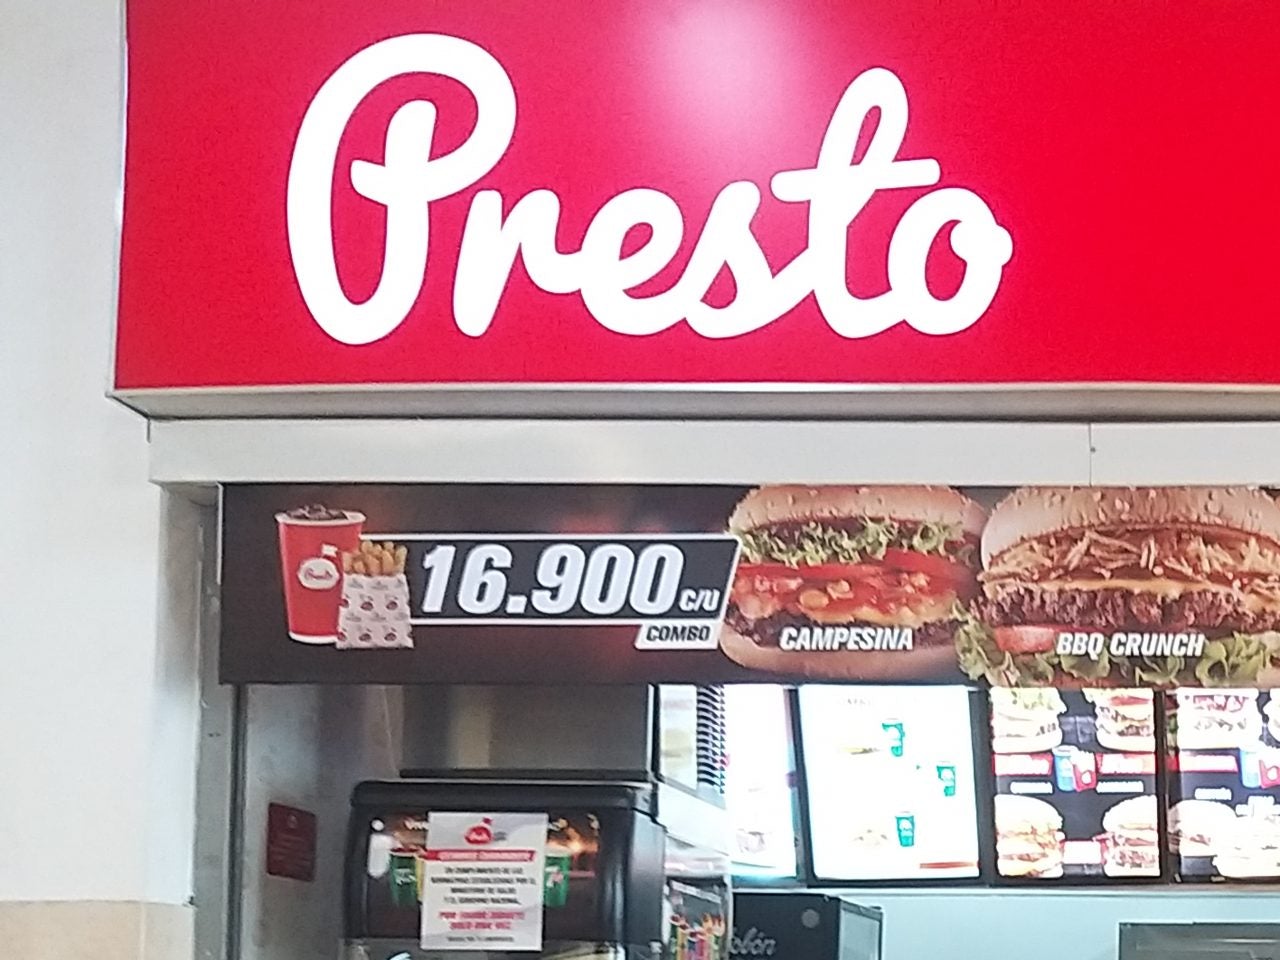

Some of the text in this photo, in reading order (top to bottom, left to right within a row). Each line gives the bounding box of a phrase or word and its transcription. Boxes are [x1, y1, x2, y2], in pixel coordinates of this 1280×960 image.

[286, 32, 1013, 345] Presto
[420, 543, 685, 614] 16.900
[646, 624, 710, 643] COMBO
[779, 627, 914, 652] CAMPESINA
[1056, 632, 1205, 657] BBQ CRUNCH
